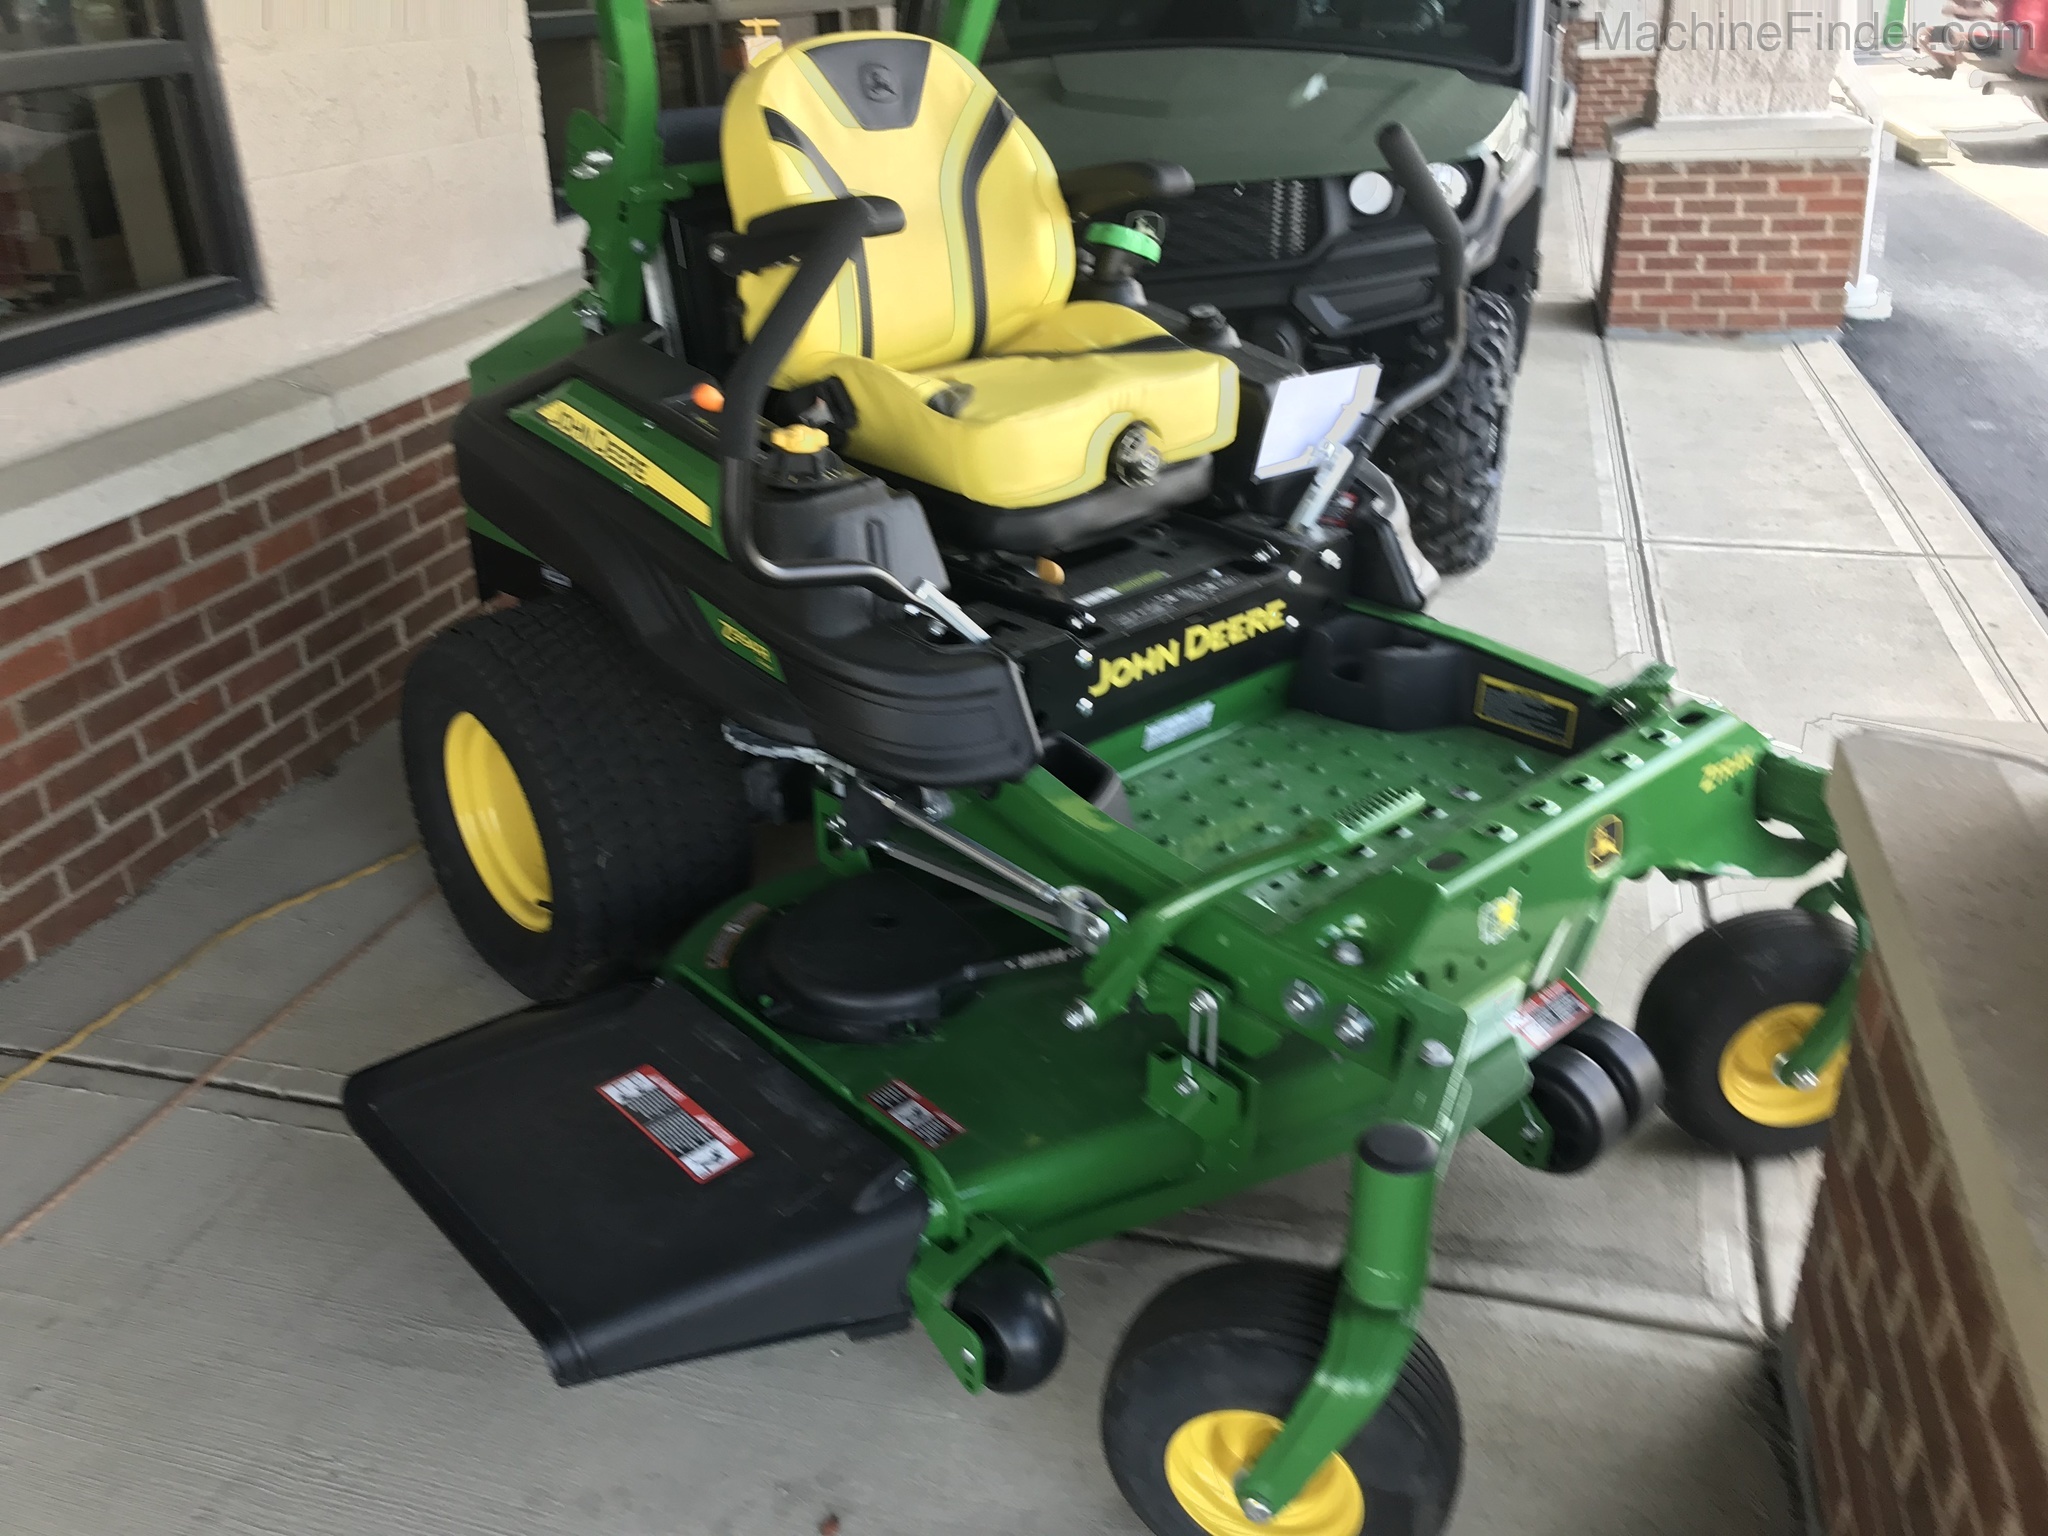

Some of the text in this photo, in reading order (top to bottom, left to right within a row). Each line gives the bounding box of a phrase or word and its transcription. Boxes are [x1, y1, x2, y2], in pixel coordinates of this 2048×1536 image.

[547, 409, 651, 485] JOHN DEERE
[1087, 637, 1181, 698] JOHN
[1183, 598, 1287, 662] DEERE
